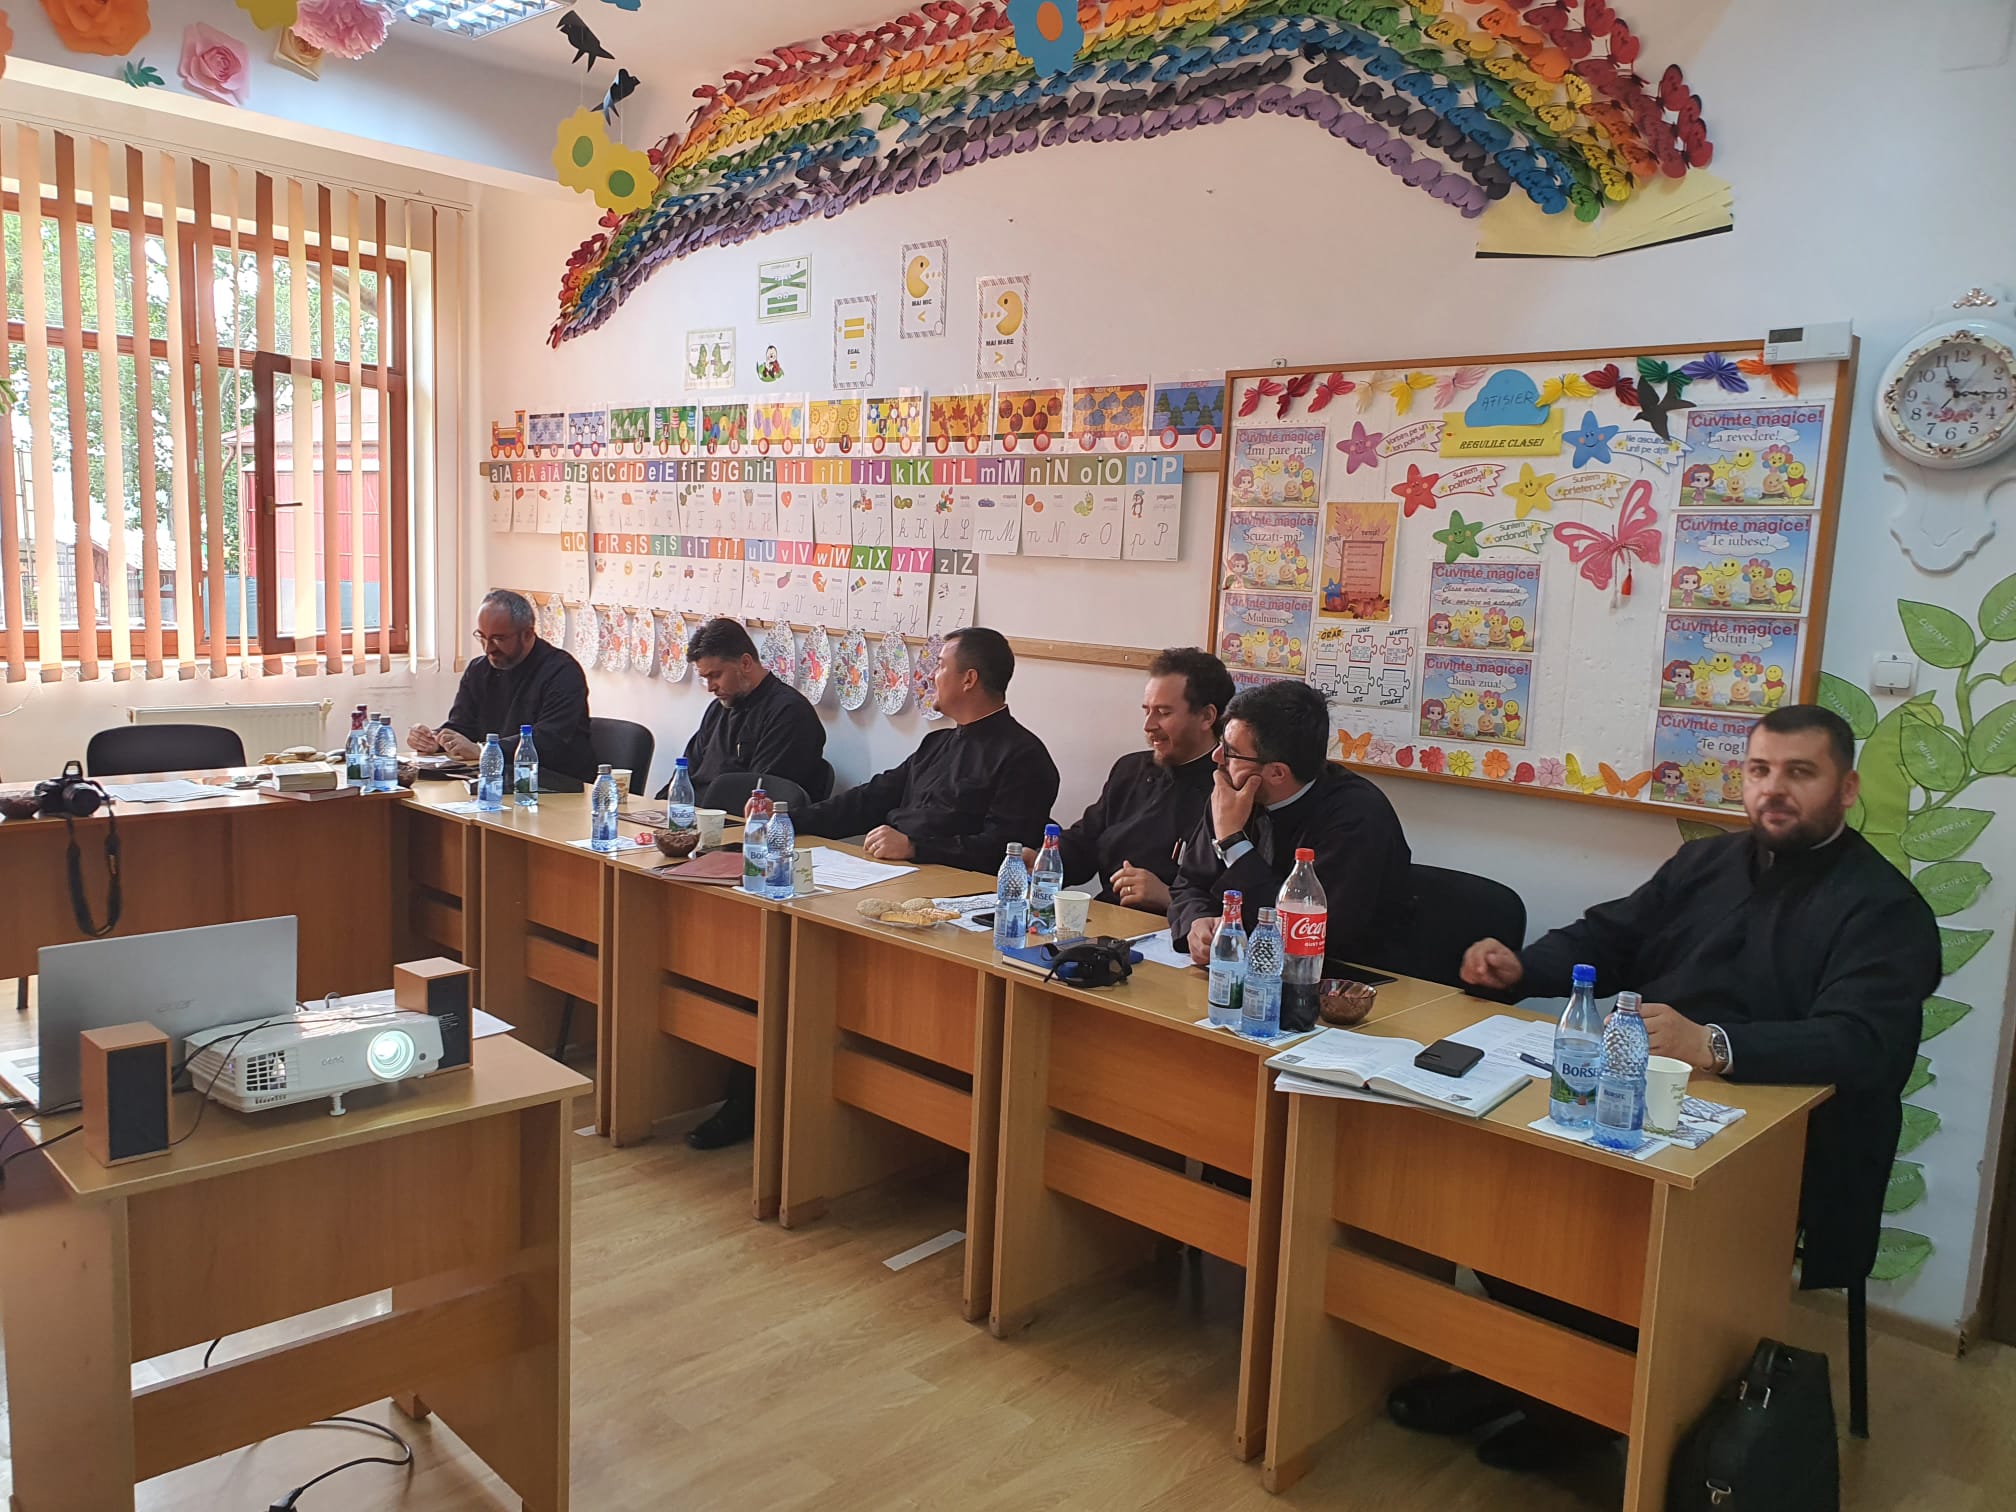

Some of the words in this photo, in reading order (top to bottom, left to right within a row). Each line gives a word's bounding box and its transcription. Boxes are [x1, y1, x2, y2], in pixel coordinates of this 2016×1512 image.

[1936, 356, 1948, 368] 11
[1955, 350, 1970, 363] 12
[1982, 354, 1986, 366] 1
[1918, 370, 1935, 383] 10
[1994, 367, 2004, 380] 2
[1906, 390, 1918, 402] 9
[1692, 413, 1750, 427] Cuvinte
[1756, 411, 1823, 427] magice!
[1911, 408, 1922, 421] 8
[1986, 407, 1996, 419] 4
[1408, 427, 1418, 437] pe
[1419, 423, 1428, 431] un
[1927, 423, 1937, 435] 7
[1945, 427, 1957, 440] 6
[1969, 422, 1979, 434] 5
[1240, 431, 1279, 442] Cuvinte
[1460, 439, 1505, 449] REGULILE
[1507, 438, 1544, 448] CLASEI
[1626, 435, 1636, 443] Ne
[1708, 432, 1722, 443] La
[1727, 430, 1780, 441] revedere!
[1269, 447, 1291, 460] pare
[492, 469, 499, 480] a
[504, 466, 512, 478] A
[564, 465, 571, 479] b
[579, 466, 587, 481] B
[592, 468, 600, 479] c
[607, 464, 616, 479] C
[620, 464, 627, 479] d
[636, 465, 645, 479] D
[649, 467, 656, 479] e
[666, 465, 674, 480] E
[681, 462, 688, 479] f
[697, 463, 705, 480] F
[711, 462, 719, 480] g
[728, 461, 739, 480] G
[744, 462, 753, 481] h
[763, 463, 774, 481] H
[859, 462, 864, 484] j
[876, 463, 886, 483] J
[896, 463, 904, 482] k
[917, 462, 929, 483] K
[961, 462, 972, 482] L
[981, 466, 996, 483] m
[1005, 459, 1020, 483] M
[1030, 466, 1041, 482] n
[1055, 459, 1069, 483] N
[1081, 467, 1092, 483] o
[1105, 457, 1123, 483] O
[1135, 461, 1146, 483] p
[1161, 457, 1177, 482] P
[1453, 467, 1478, 480] Suntem
[1572, 474, 1600, 483] Suntem
[1233, 515, 1275, 526] Cuvinte
[1500, 522, 1525, 531] Suntem
[1680, 518, 1738, 532] Cuvinte
[1743, 519, 1810, 534] magice!
[564, 536, 570, 548] q
[576, 534, 586, 550] Q
[598, 539, 604, 551] r
[609, 537, 619, 552] R
[625, 541, 632, 552] s
[640, 539, 648, 553] S
[687, 542, 692, 556] t
[701, 540, 709, 554] T
[1712, 535, 1723, 545] Te
[1728, 536, 1770, 546] iubesc!
[748, 548, 756, 560] u
[765, 543, 775, 559] U
[781, 551, 789, 561] v
[798, 545, 810, 563] V
[817, 553, 827, 564] w
[835, 548, 851, 566] W
[856, 556, 864, 567] x
[875, 550, 888, 568] X
[897, 554, 905, 569] y
[917, 552, 930, 570] Y
[940, 560, 948, 572] z
[962, 554, 972, 573] Z
[1436, 566, 1482, 578] Cuvinte
[1487, 568, 1539, 582] magice!
[1321, 630, 1341, 640] ORAR
[1670, 619, 1728, 633] Cuvinte
[1733, 622, 1798, 637] magice!
[1427, 658, 1472, 670] Cuvinte
[1477, 663, 1529, 676] magice!
[1478, 680, 1502, 688] ziua!
[1662, 715, 1718, 731] Cuvinte
[1702, 738, 1715, 749] Te
[1719, 741, 1745, 754] rog!
[672, 811, 693, 819] BORSE
[1562, 1062, 1601, 1078] BORSE
